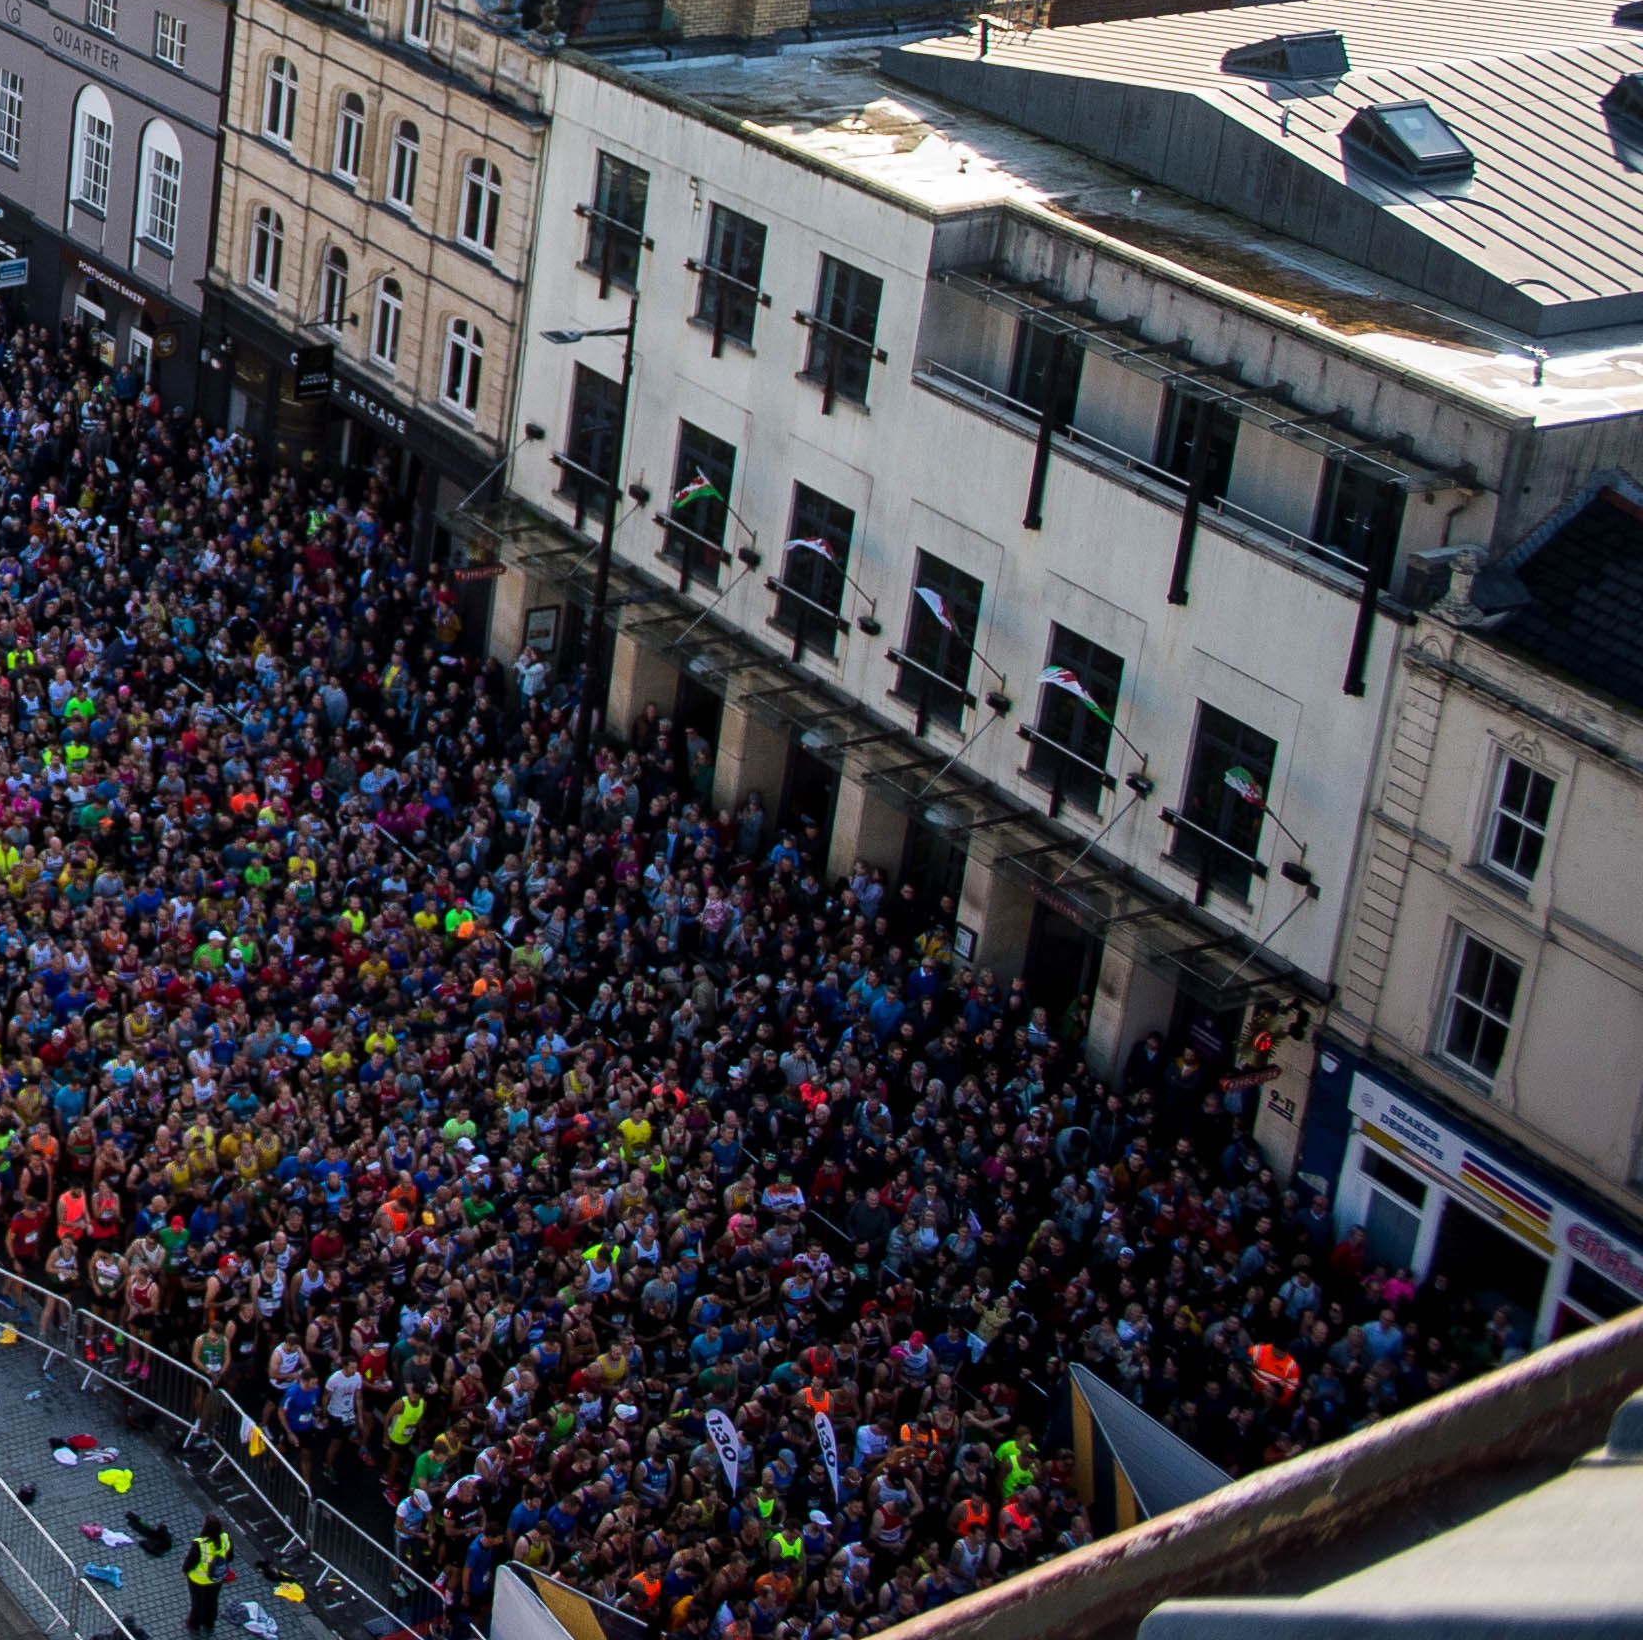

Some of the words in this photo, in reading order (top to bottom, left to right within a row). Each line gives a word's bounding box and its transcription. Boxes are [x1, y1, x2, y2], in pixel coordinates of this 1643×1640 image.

[52, 25, 119, 73] QUARTER
[78, 260, 120, 292] PORTUGUESE
[121, 285, 146, 306] BAKERY
[349, 390, 406, 434] ARCADE
[1270, 1090, 1295, 1114] 9-11
[1389, 1105, 1440, 1142] SHAKES
[1379, 1112, 1444, 1160] DESSERTS
[709, 1416, 737, 1462] 1:30
[816, 1418, 836, 1467] 1:30
